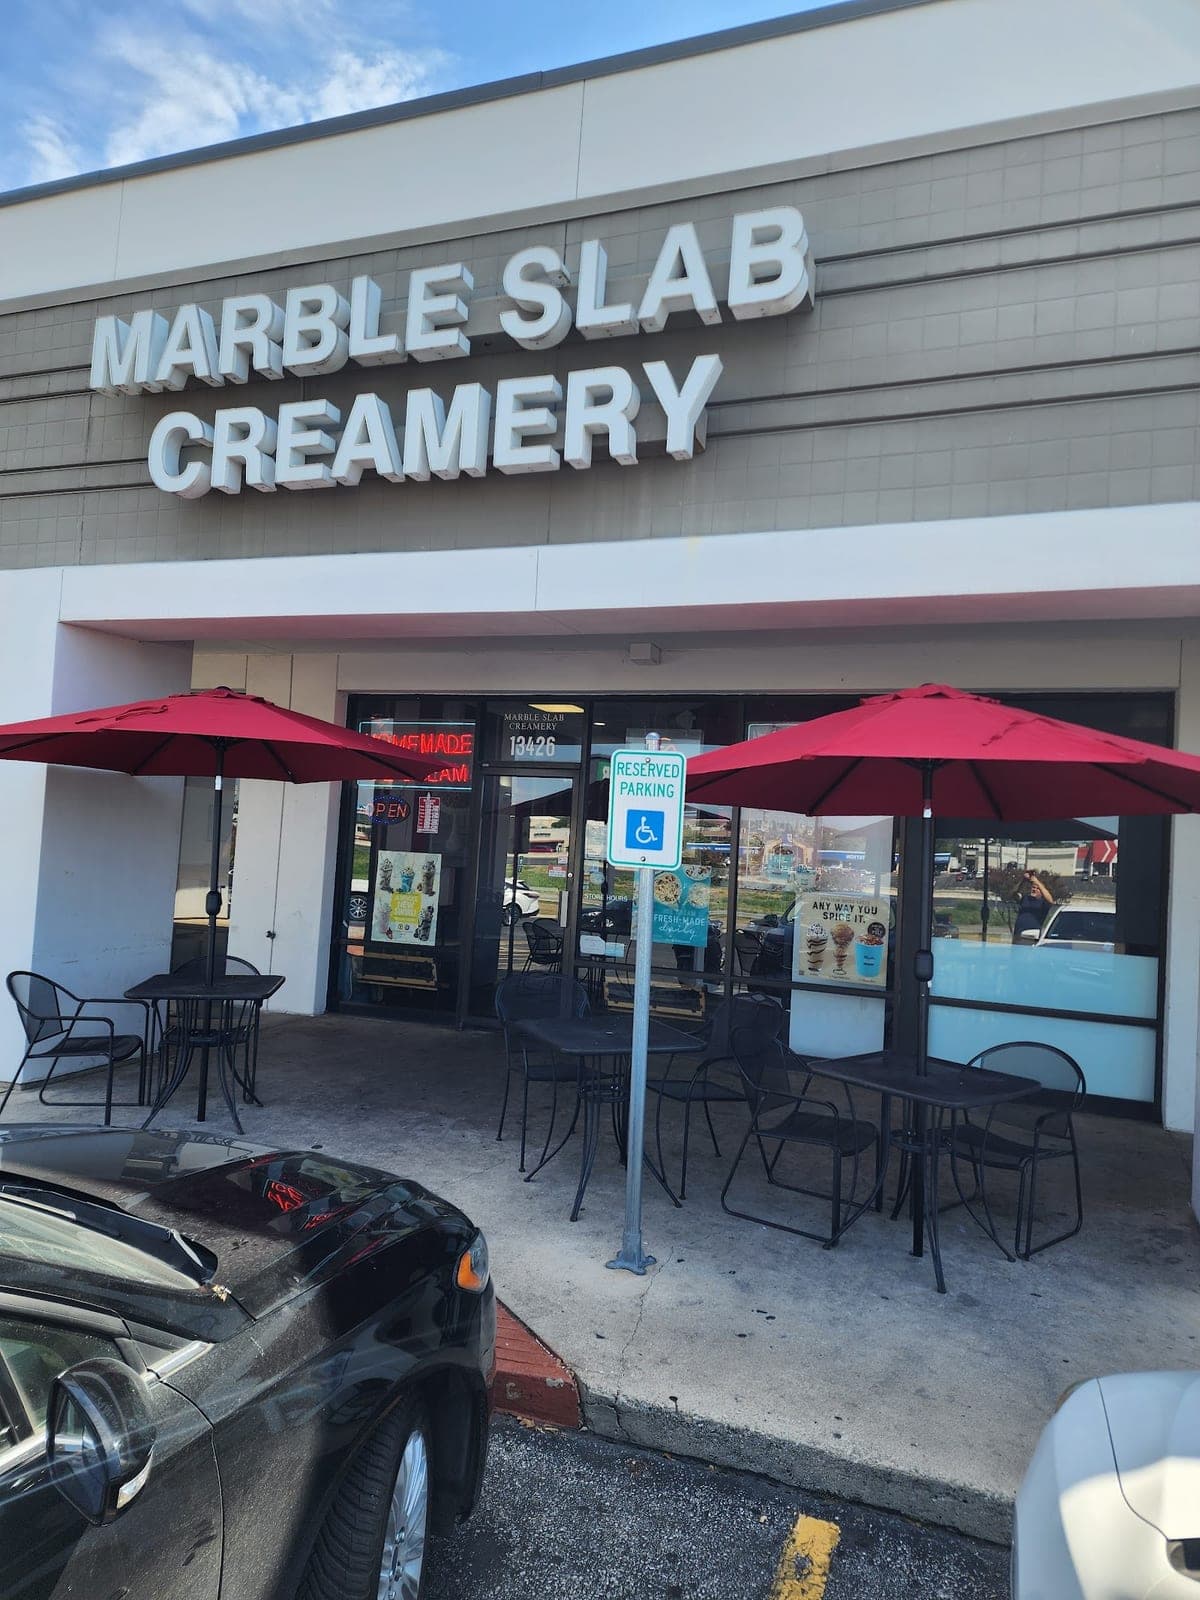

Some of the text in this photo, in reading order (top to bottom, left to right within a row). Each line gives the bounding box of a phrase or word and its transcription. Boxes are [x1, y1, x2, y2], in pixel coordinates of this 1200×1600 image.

[91, 205, 814, 396] MARBLE SLAB
[147, 354, 723, 499] CREAMERY
[504, 713, 565, 722] MARBLE SLAB
[509, 722, 558, 731] CREAMERY
[509, 735, 556, 757] 13426
[617, 762, 680, 778] RESERVED
[620, 781, 674, 798] PARKING
[368, 802, 408, 818] OPEN
[584, 893, 628, 903] STORE HOURS
[812, 901, 831, 911] ANY
[834, 903, 855, 913] WAY
[858, 905, 878, 915] YOU
[823, 911, 866, 924] SPICE IT.
